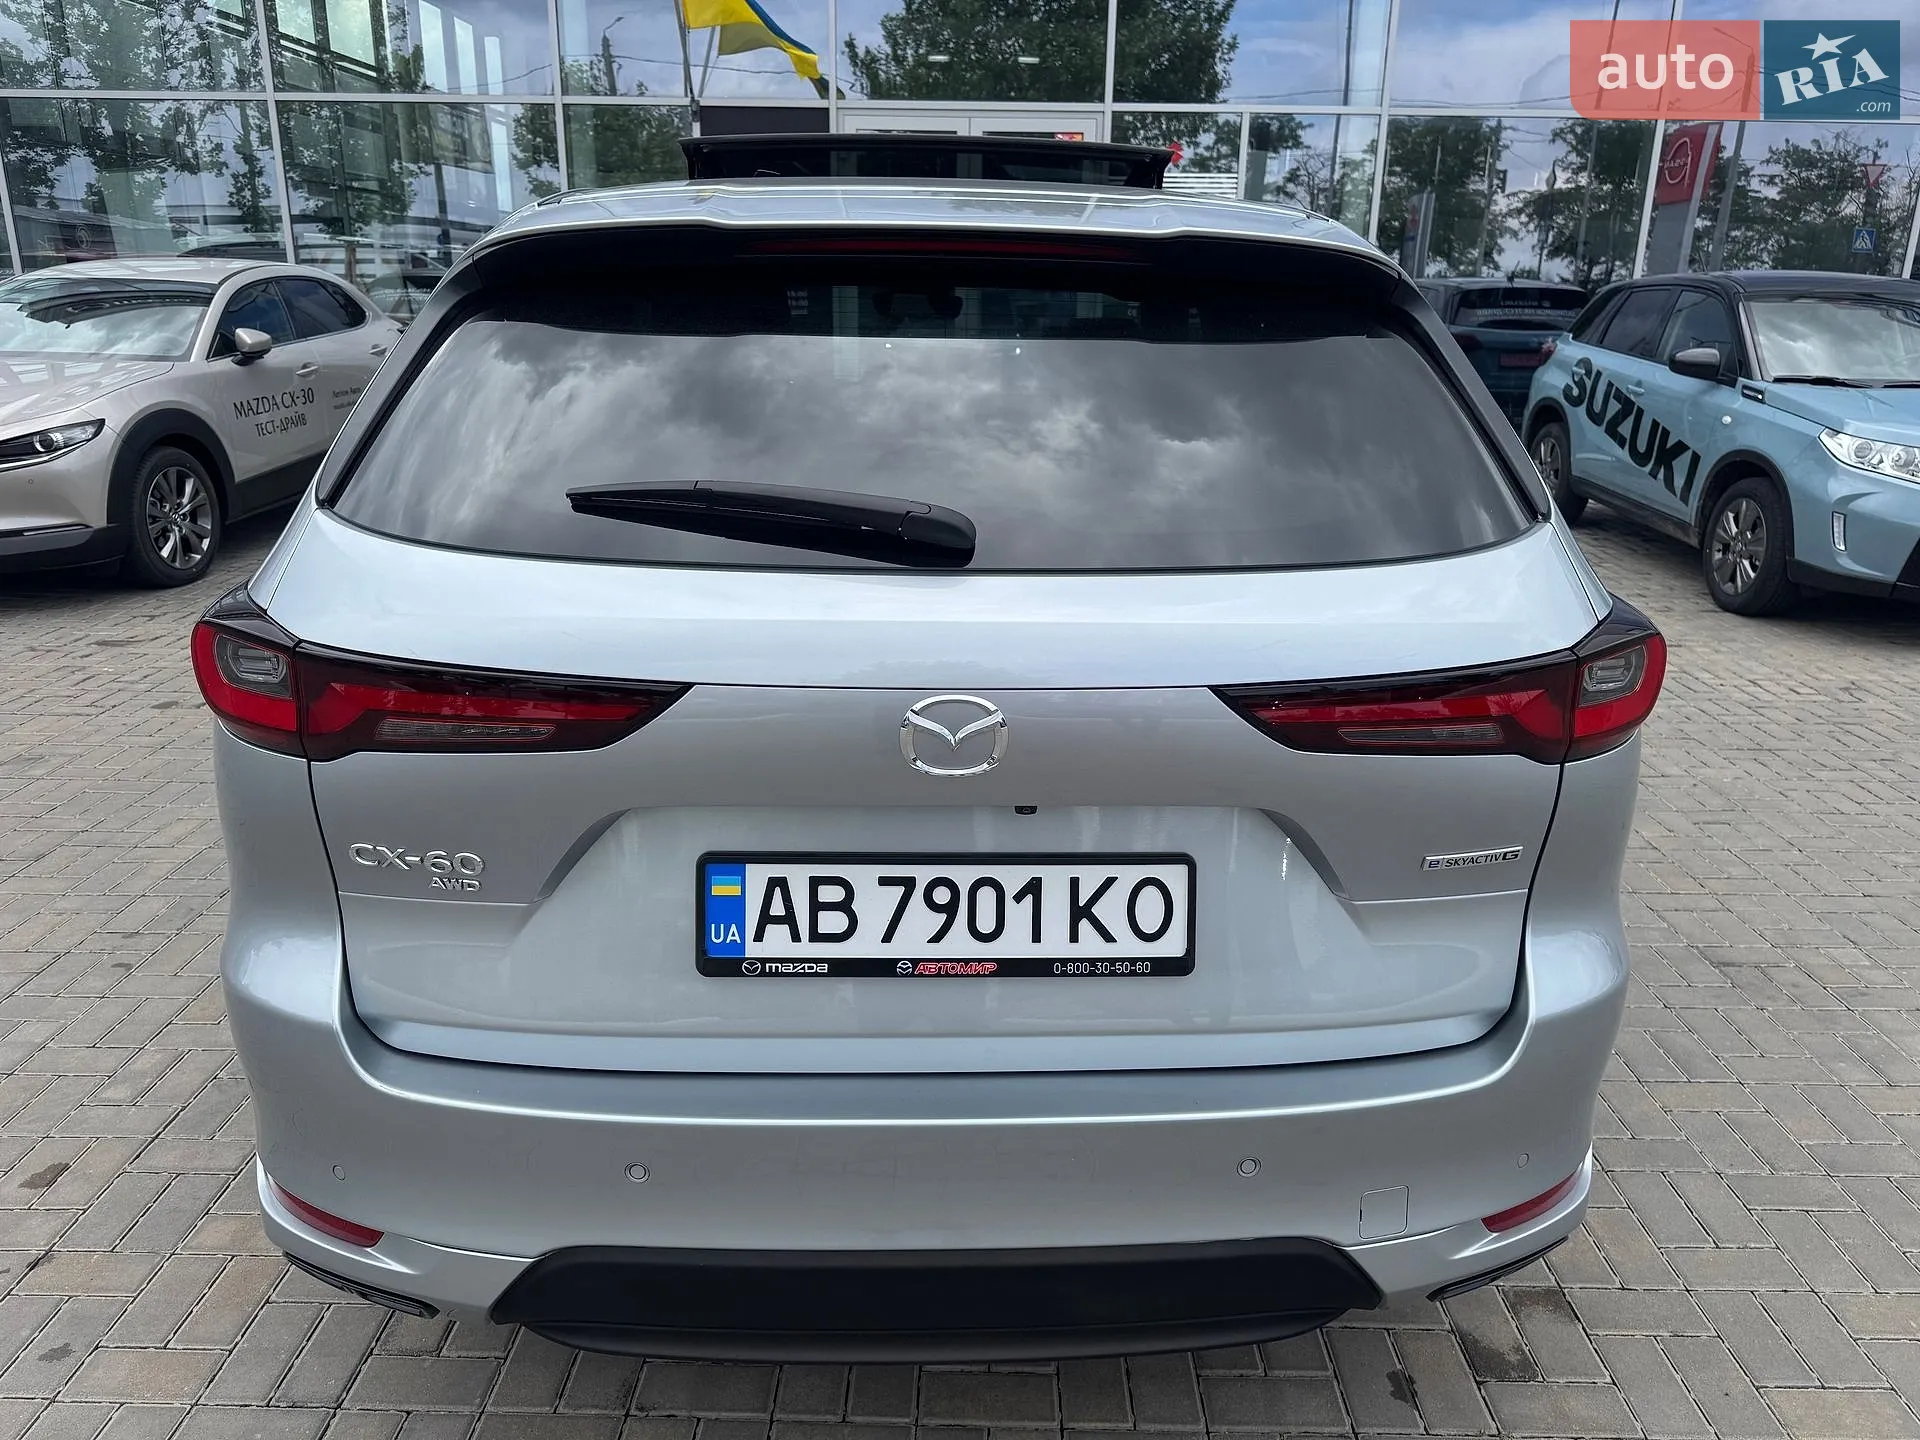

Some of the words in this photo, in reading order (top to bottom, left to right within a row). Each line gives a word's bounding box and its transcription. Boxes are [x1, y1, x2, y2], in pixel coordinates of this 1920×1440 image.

[233, 394, 280, 420] MAZDA
[281, 387, 315, 409] CX-30
[255, 412, 308, 437] ТЕСТ-ДРАЙВ
[1562, 357, 1702, 507] SUZUKI
[349, 842, 485, 876] CX-60
[428, 876, 482, 891] AWD
[752, 875, 859, 943] AB
[877, 875, 1043, 944] 7901
[1068, 875, 1175, 944] KO
[711, 923, 742, 944] UA
[765, 962, 829, 973] mazda
[914, 962, 998, 975] АВТОМИР
[1053, 961, 1152, 974] 0-800-30-50-60
